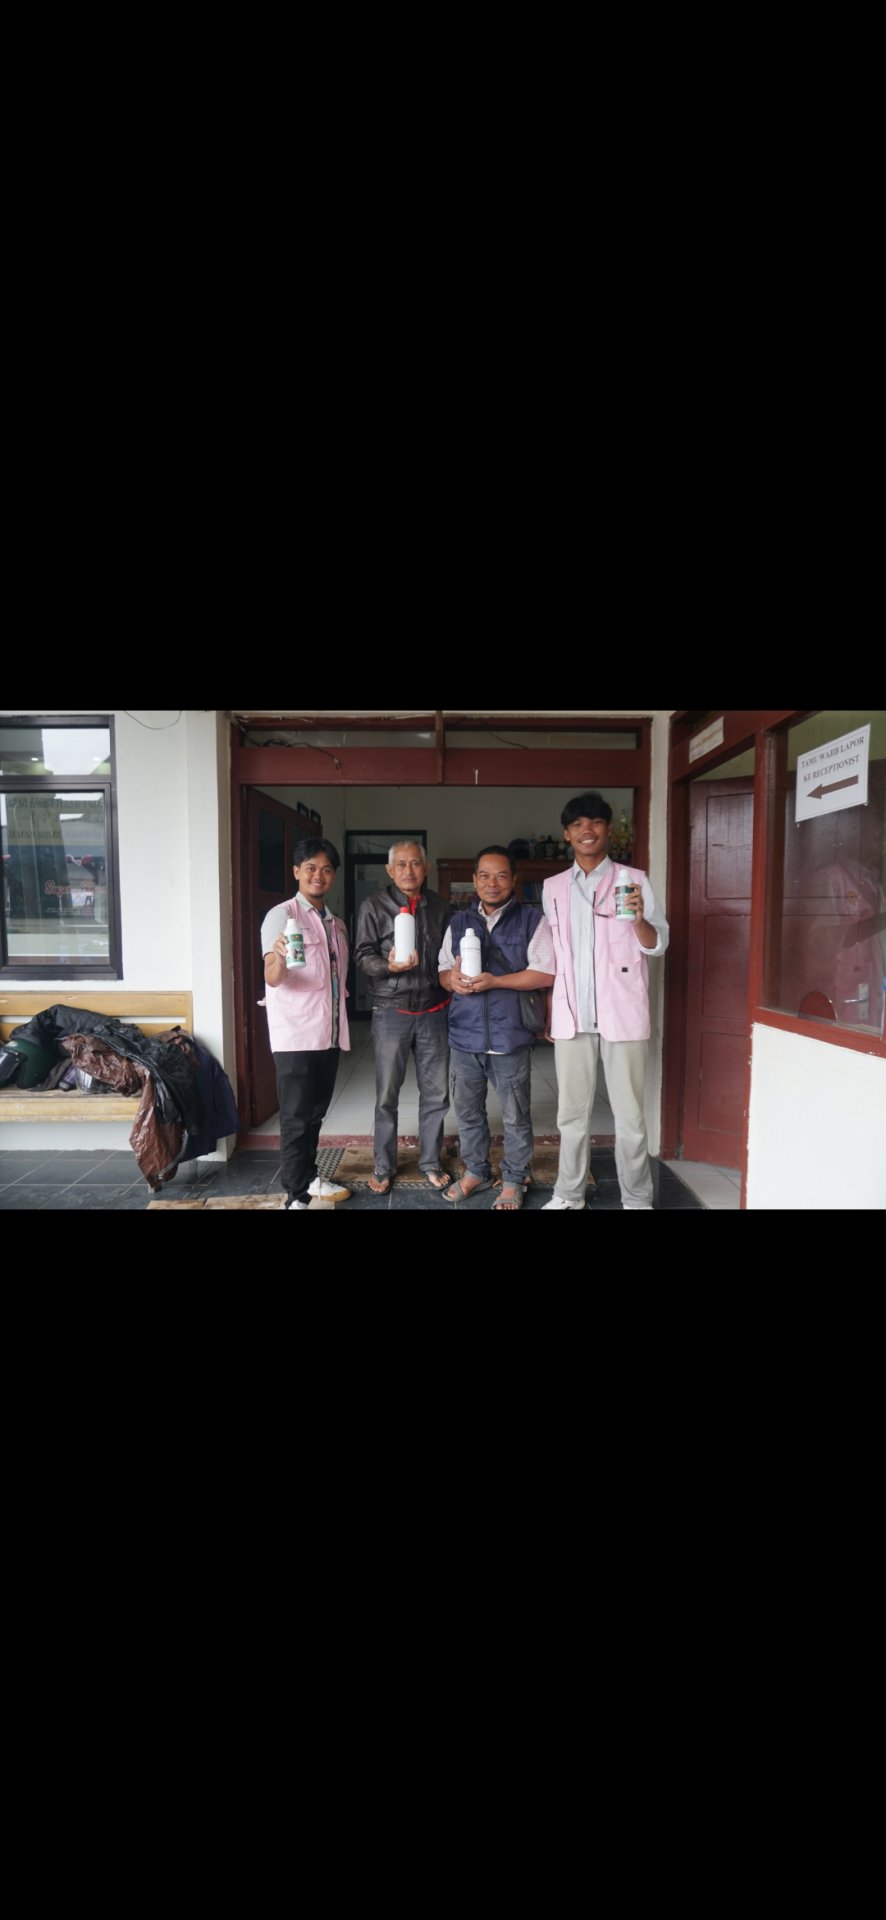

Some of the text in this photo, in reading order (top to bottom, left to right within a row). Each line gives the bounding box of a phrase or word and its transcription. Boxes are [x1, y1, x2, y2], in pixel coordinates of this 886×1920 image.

[819, 747, 839, 760] WAJIB
[841, 736, 864, 753] LAPOR
[813, 754, 859, 778] RECEPTIONIST
